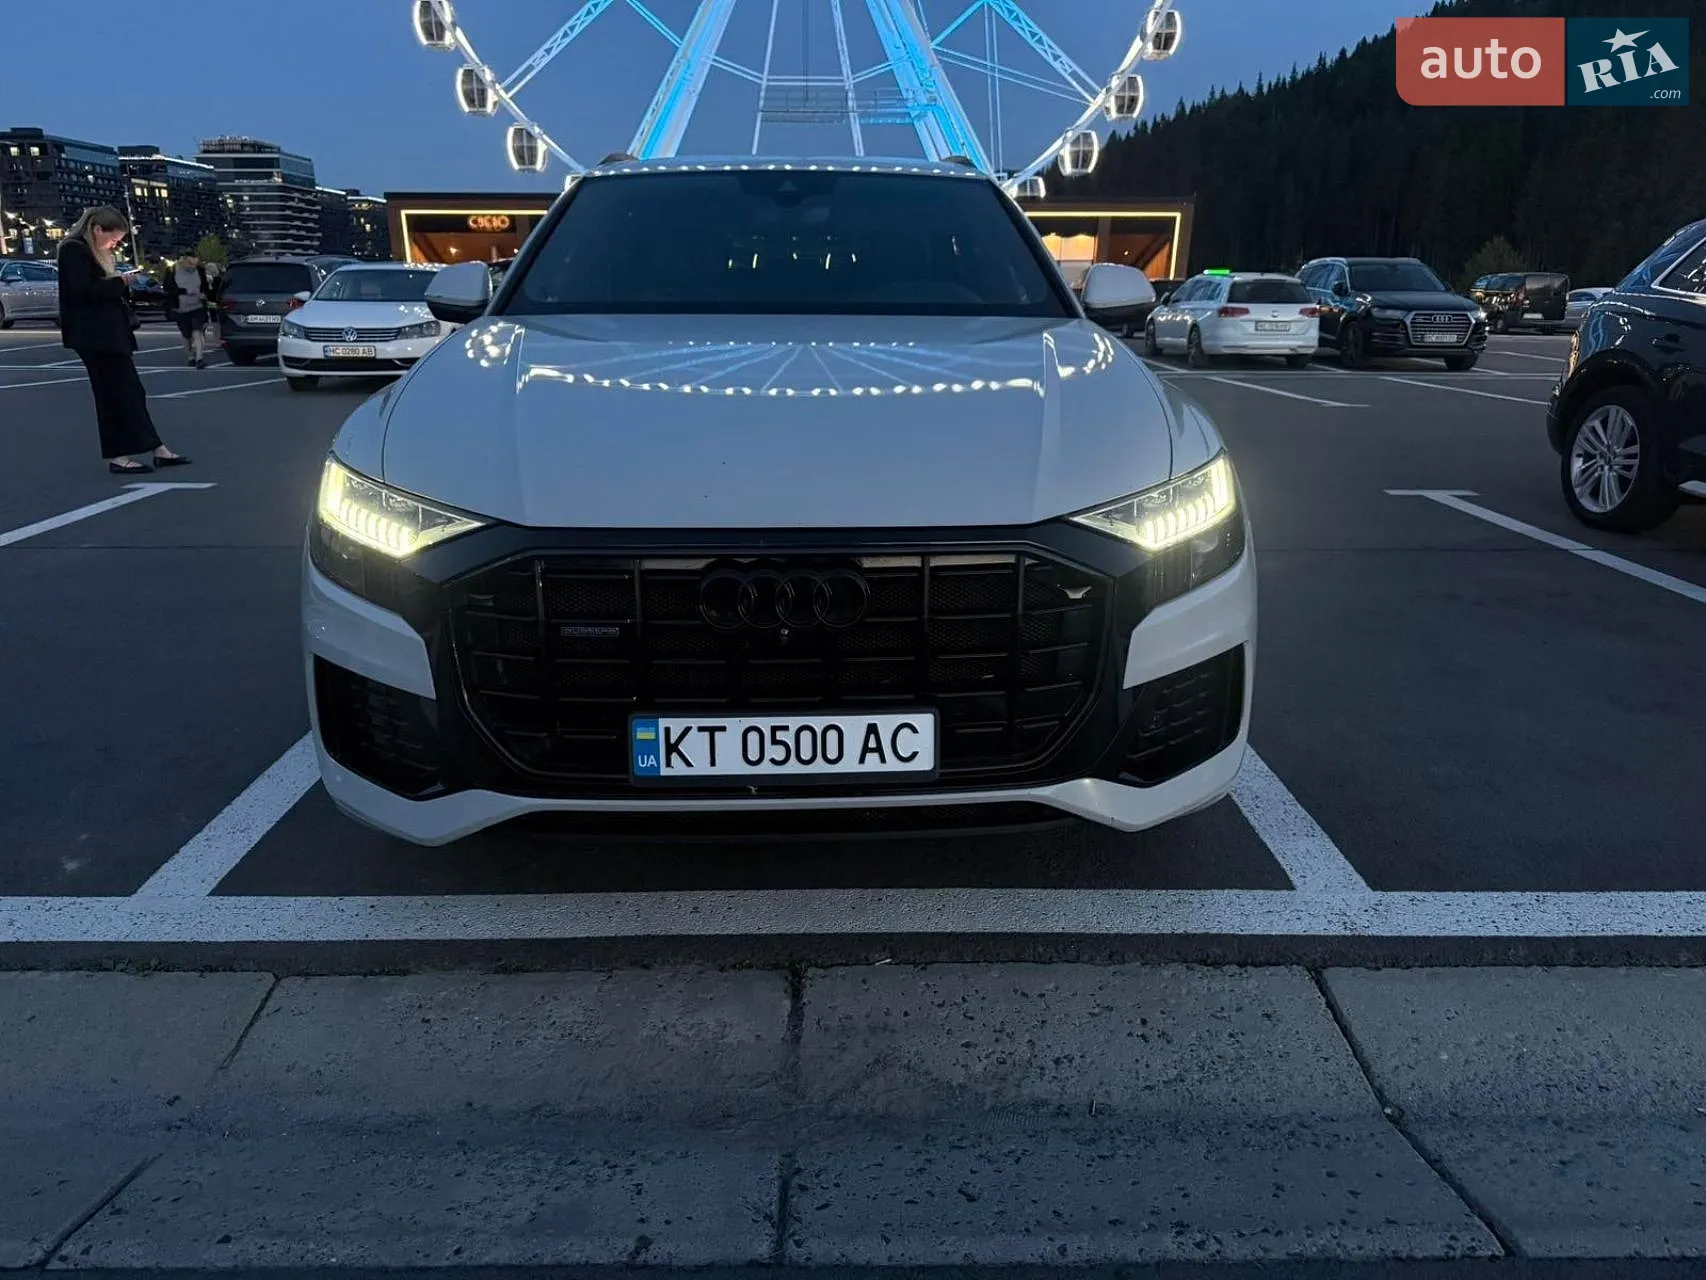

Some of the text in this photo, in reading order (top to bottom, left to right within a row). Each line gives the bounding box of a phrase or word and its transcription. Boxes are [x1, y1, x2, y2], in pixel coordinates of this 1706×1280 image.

[663, 721, 920, 768] KT 0500 AC
[638, 755, 658, 769] UA
